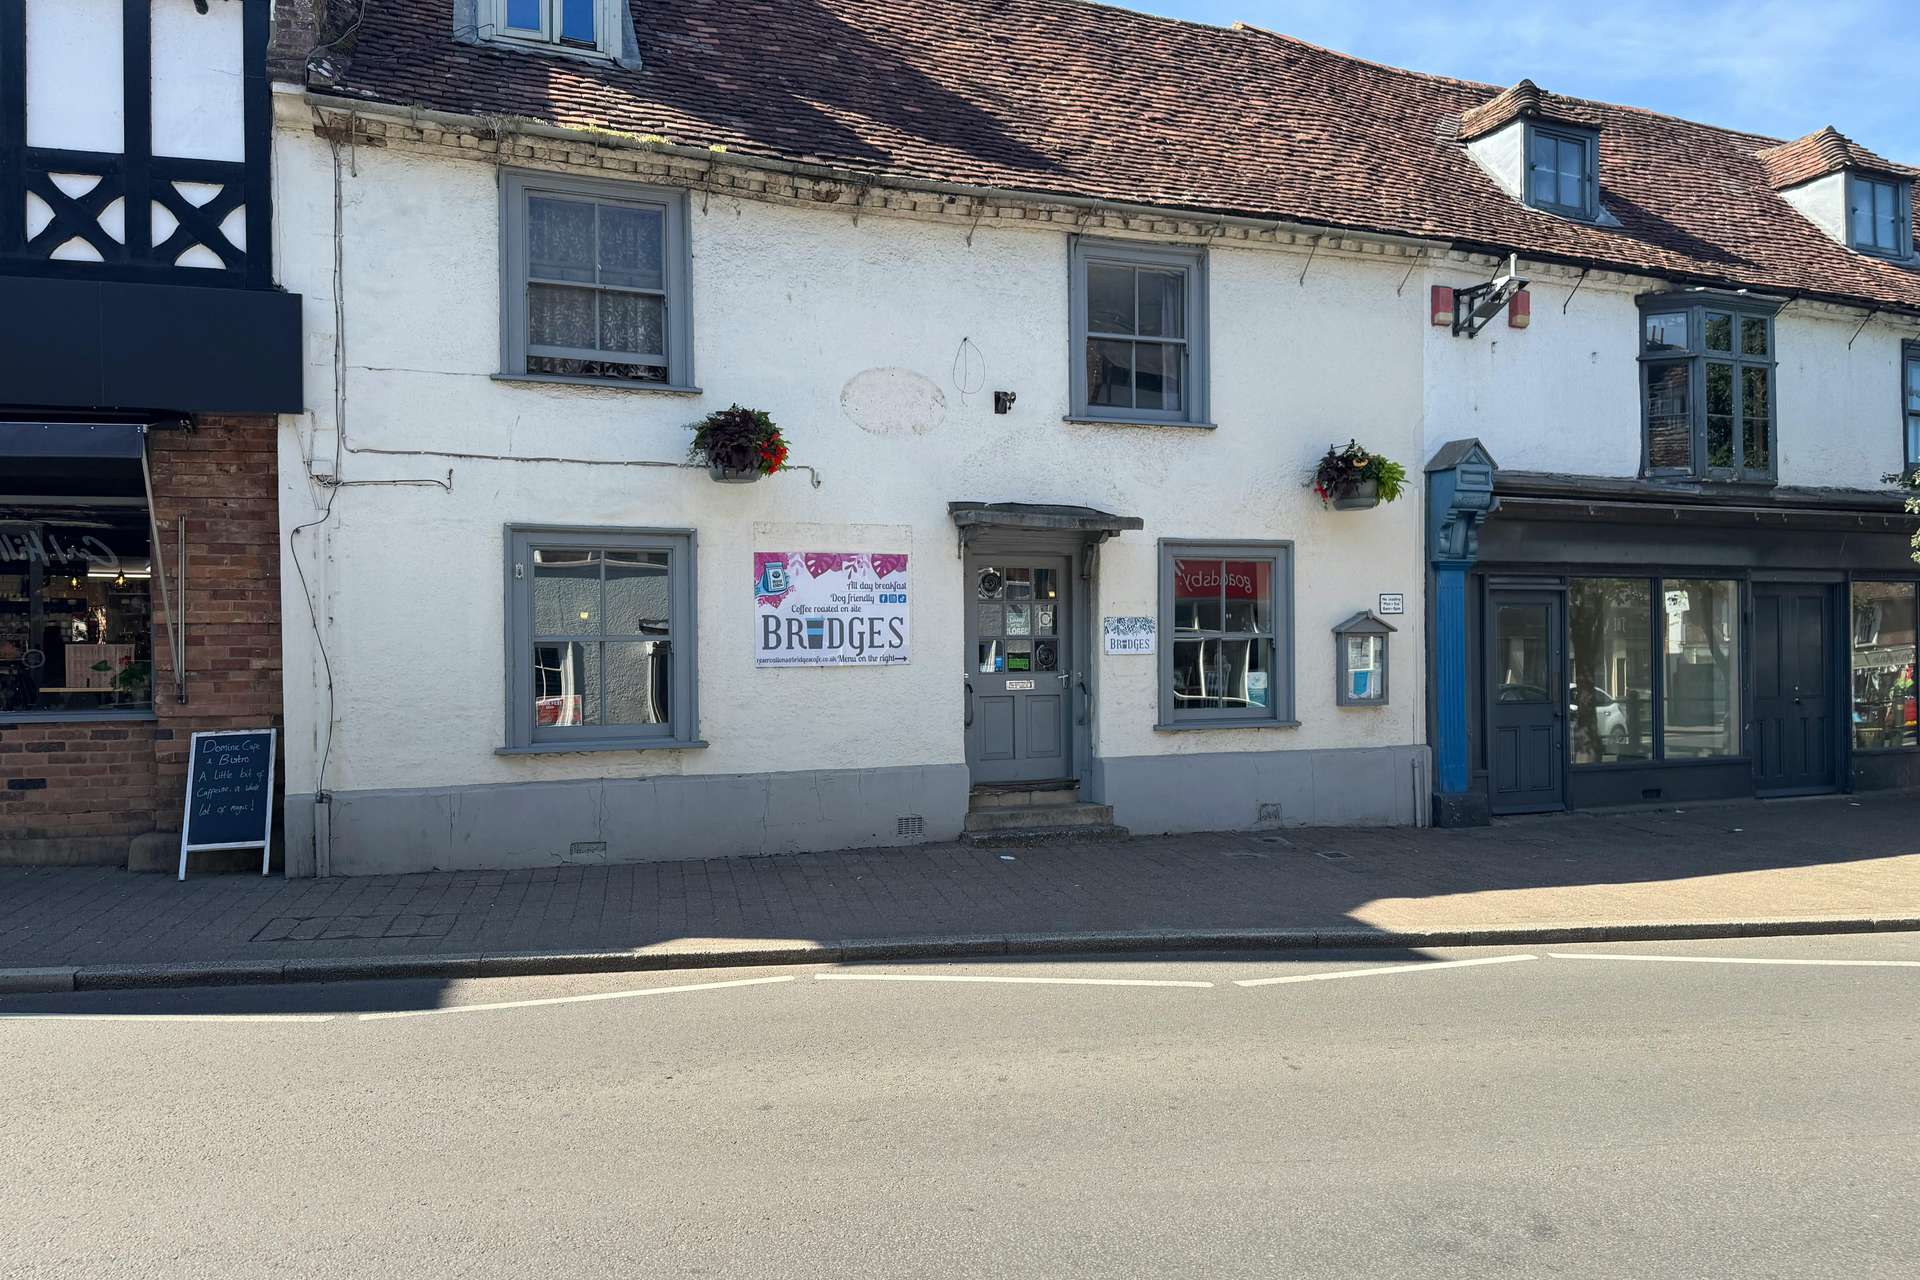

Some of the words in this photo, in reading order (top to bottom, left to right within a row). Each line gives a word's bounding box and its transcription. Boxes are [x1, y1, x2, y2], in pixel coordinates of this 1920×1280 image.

[847, 581, 858, 590] All
[860, 582, 873, 592] day
[874, 581, 907, 592] breakfast
[831, 594, 846, 604] Dog
[847, 594, 875, 605] friendly
[791, 604, 812, 615] Coffee
[813, 605, 838, 613] roasted
[851, 605, 862, 613] site
[762, 615, 904, 657] BRIDGES
[1110, 638, 1150, 651] BRIDGES
[838, 654, 857, 663] Menu
[858, 655, 866, 663] on
[867, 654, 878, 662] the
[879, 654, 896, 663] right
[218, 754, 249, 765] Bistro
[198, 771, 206, 783] A
